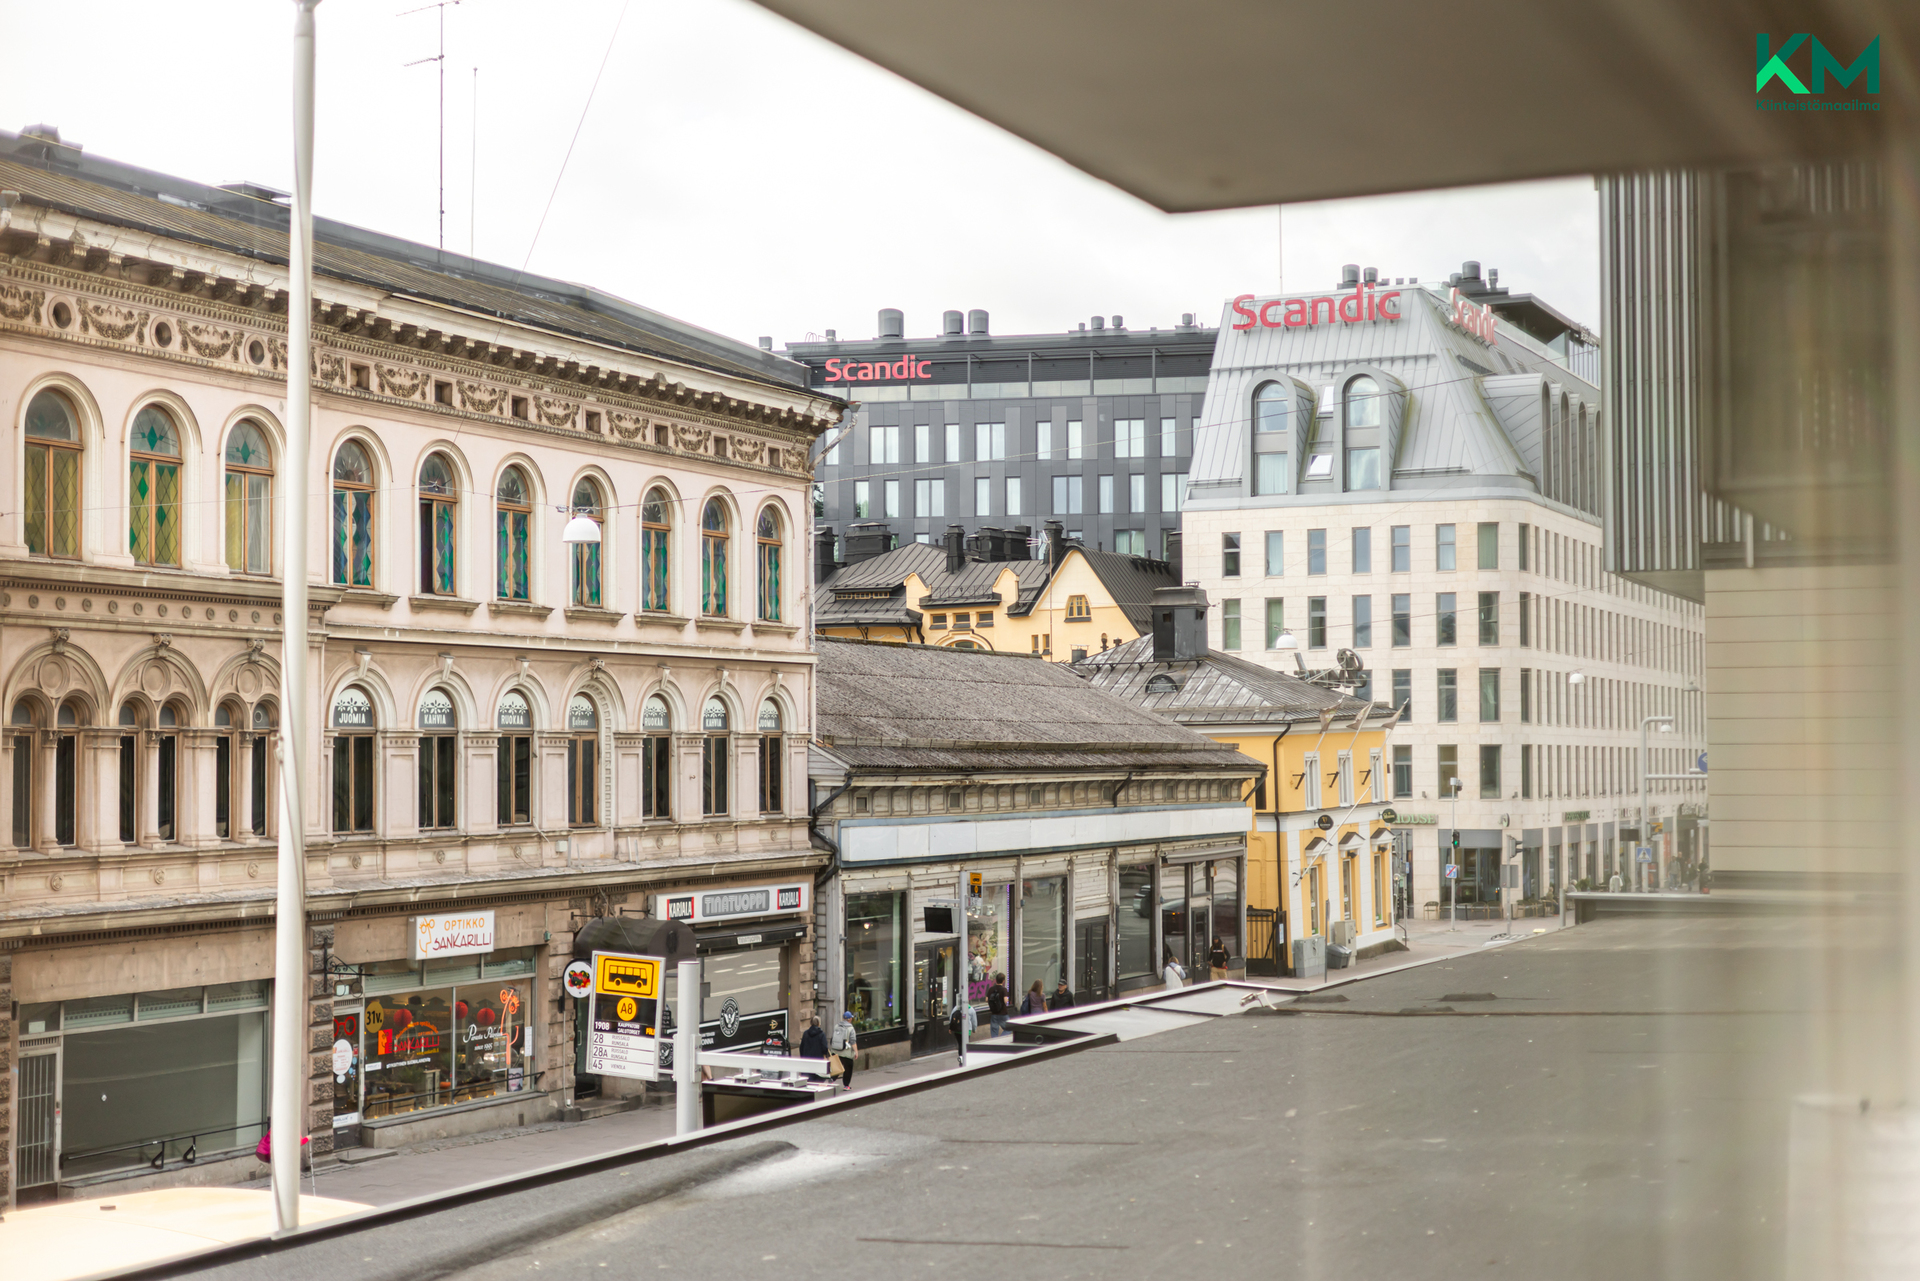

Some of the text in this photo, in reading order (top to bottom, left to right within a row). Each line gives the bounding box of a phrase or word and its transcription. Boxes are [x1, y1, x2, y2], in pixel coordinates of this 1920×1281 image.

[1232, 282, 1402, 331] Scandic
[1449, 286, 1498, 346] Scandic
[825, 354, 931, 382] Scandic
[338, 713, 366, 724] JUOMIA
[424, 714, 447, 725] KAHVIA
[501, 715, 524, 725] RUOKAA
[644, 717, 663, 727] RUOKAA
[705, 718, 722, 728] KAHVIA
[759, 719, 775, 728] JUOMIA
[704, 892, 766, 914] TINATUOPPI
[778, 891, 800, 907] KARJALA
[668, 900, 692, 918] KARJALA
[444, 917, 485, 931] OPTIKKO
[432, 932, 492, 951] SANKARILLI
[620, 1002, 633, 1015] A8
[366, 1011, 382, 1025] 31v.
[594, 1021, 610, 1030] 1908
[593, 1033, 604, 1044] 28
[593, 1046, 608, 1057] 28A
[592, 1060, 603, 1069] 45
